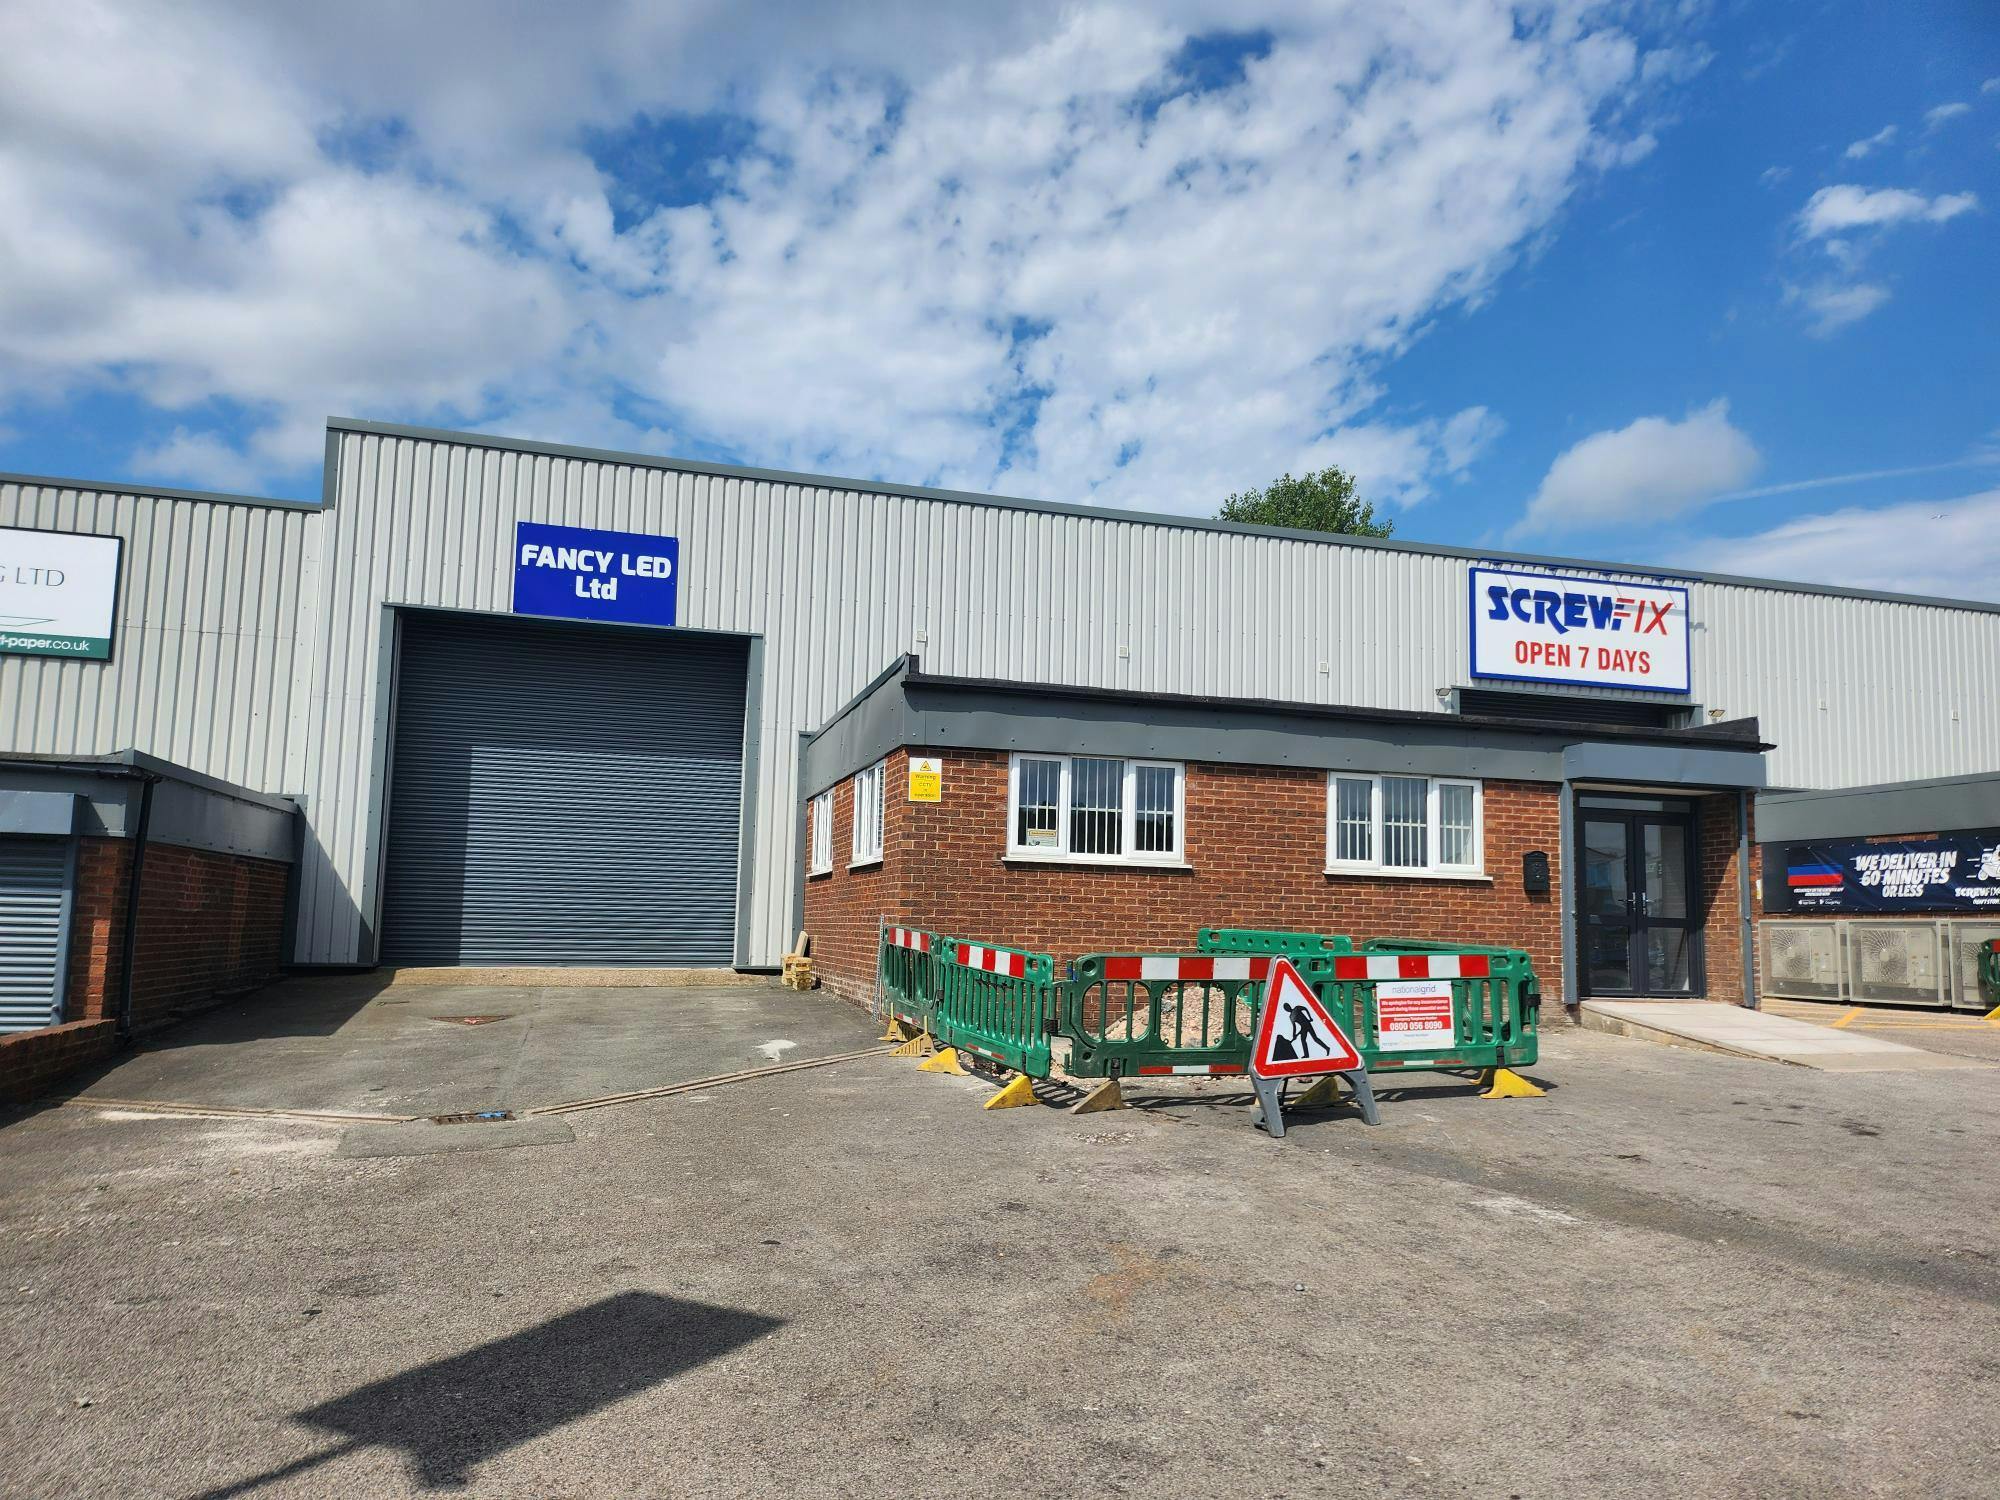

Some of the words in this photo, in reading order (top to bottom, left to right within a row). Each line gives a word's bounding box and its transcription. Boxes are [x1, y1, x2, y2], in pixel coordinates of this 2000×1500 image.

[521, 543, 614, 574] FANCY
[621, 553, 672, 579] LED
[15, 566, 65, 587] LTD
[575, 575, 618, 601] Ltd
[1487, 585, 1674, 636] SCREWFIX
[1515, 640, 1571, 668] OPEN
[1578, 646, 1590, 669] 7
[1598, 647, 1651, 675] DAYS
[1855, 854, 1880, 872] WE
[1879, 852, 1937, 870] DELIVER
[1938, 850, 1958, 868] IN
[1860, 870, 1881, 887] 60
[1882, 867, 1950, 885] MINUTES
[1882, 885, 1898, 898] OR
[1898, 884, 1924, 898] LESS
[1389, 1022, 1408, 1031] 0800
[1409, 1021, 1423, 1030] 056
[1424, 1020, 1443, 1030] 8090
